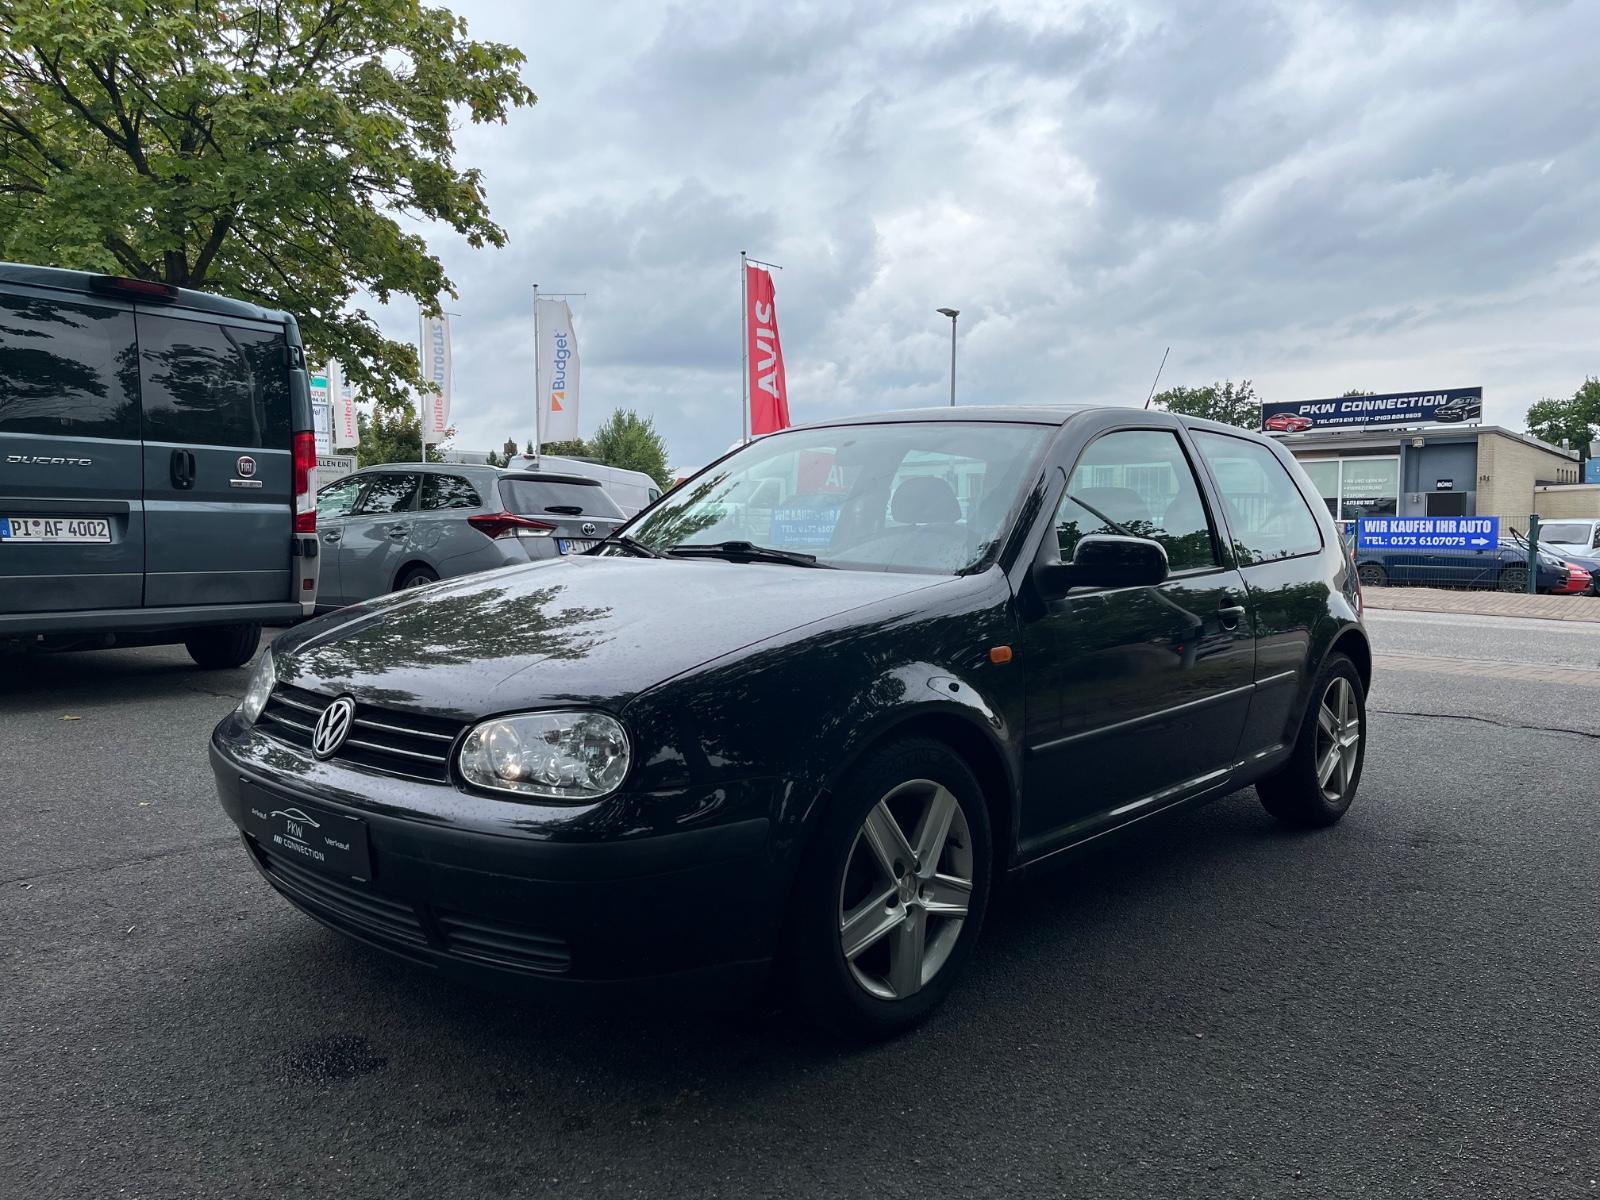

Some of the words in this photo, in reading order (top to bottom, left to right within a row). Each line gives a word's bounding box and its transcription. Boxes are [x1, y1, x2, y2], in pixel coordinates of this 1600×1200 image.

[755, 299, 781, 399] AVIS
[553, 332, 571, 390] Budget
[1298, 403, 1336, 415] PKW
[1341, 394, 1448, 412] CONNECTION
[6, 455, 92, 466] DUCATO
[240, 462, 253, 473] FIAT
[11, 520, 32, 537] PI
[44, 521, 63, 537] AF
[68, 521, 107, 537] 4002
[1364, 520, 1388, 533] WIR
[1390, 520, 1434, 533] KAUFEN
[1436, 520, 1457, 533] IHR
[1459, 520, 1491, 533] AUTO
[1364, 536, 1388, 545] TEL:
[1390, 537, 1416, 545] 0173
[1418, 537, 1466, 545] 6107075
[287, 820, 303, 838] PKW
[283, 838, 325, 861] CONNECTION
[324, 836, 350, 851] Verkauf
